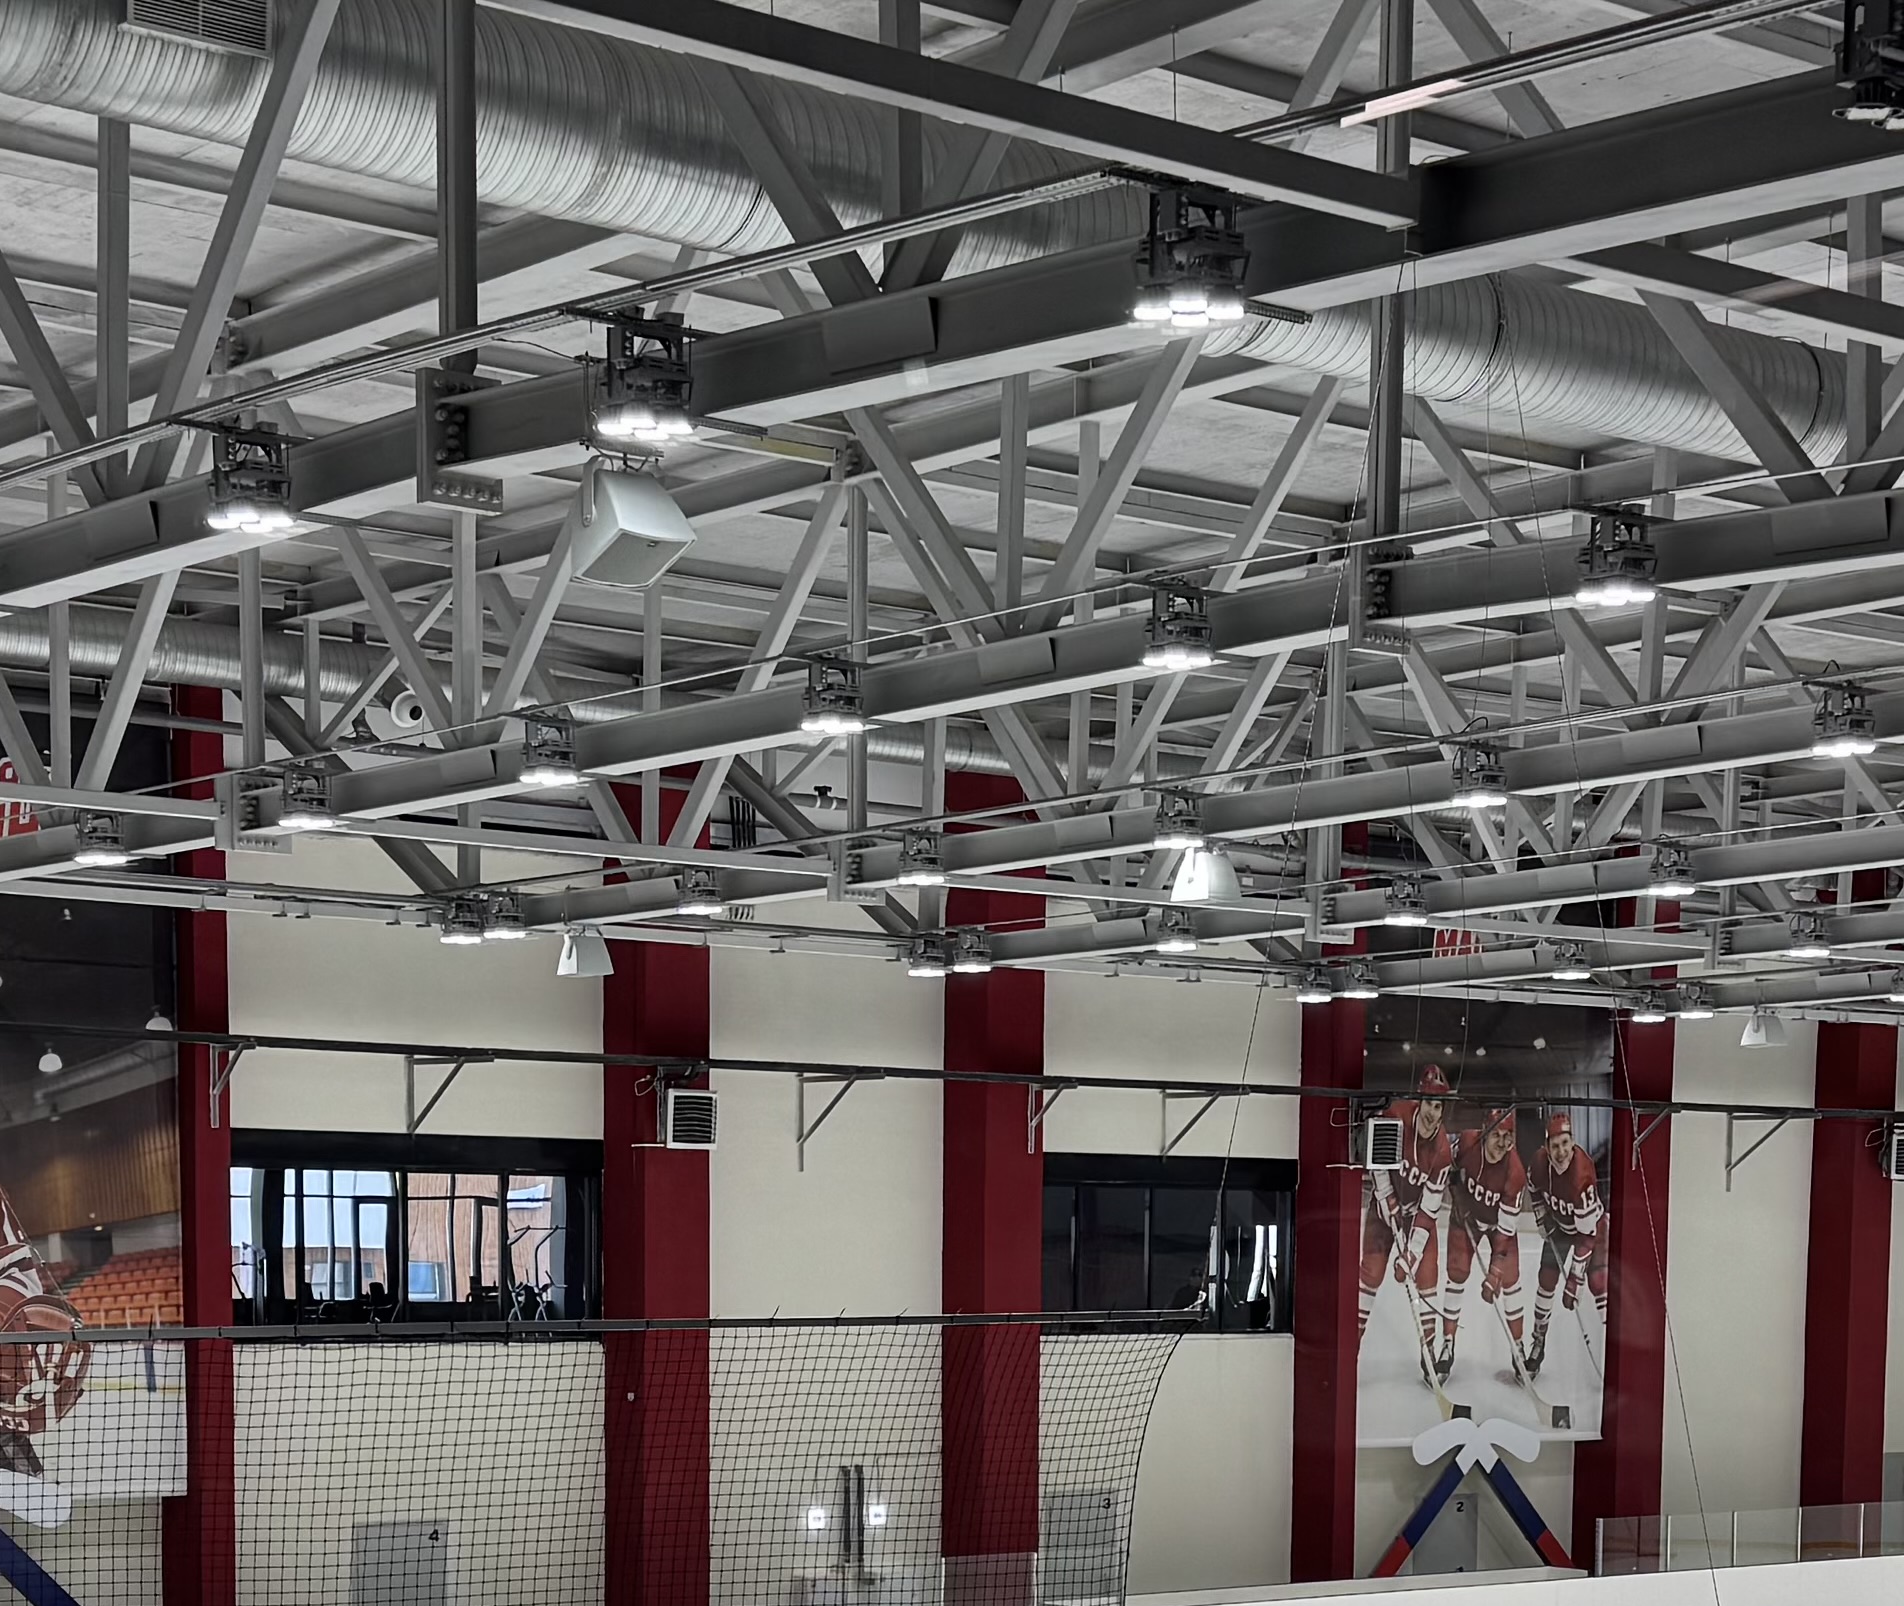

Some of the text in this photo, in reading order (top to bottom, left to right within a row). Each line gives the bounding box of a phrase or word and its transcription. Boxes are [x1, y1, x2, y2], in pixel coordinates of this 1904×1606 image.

[1467, 1177, 1501, 1207] СССР
[1580, 1184, 1595, 1210] 13
[1102, 1497, 1111, 1509] 3
[1456, 1501, 1465, 1513] 2
[428, 1528, 440, 1542] 4
